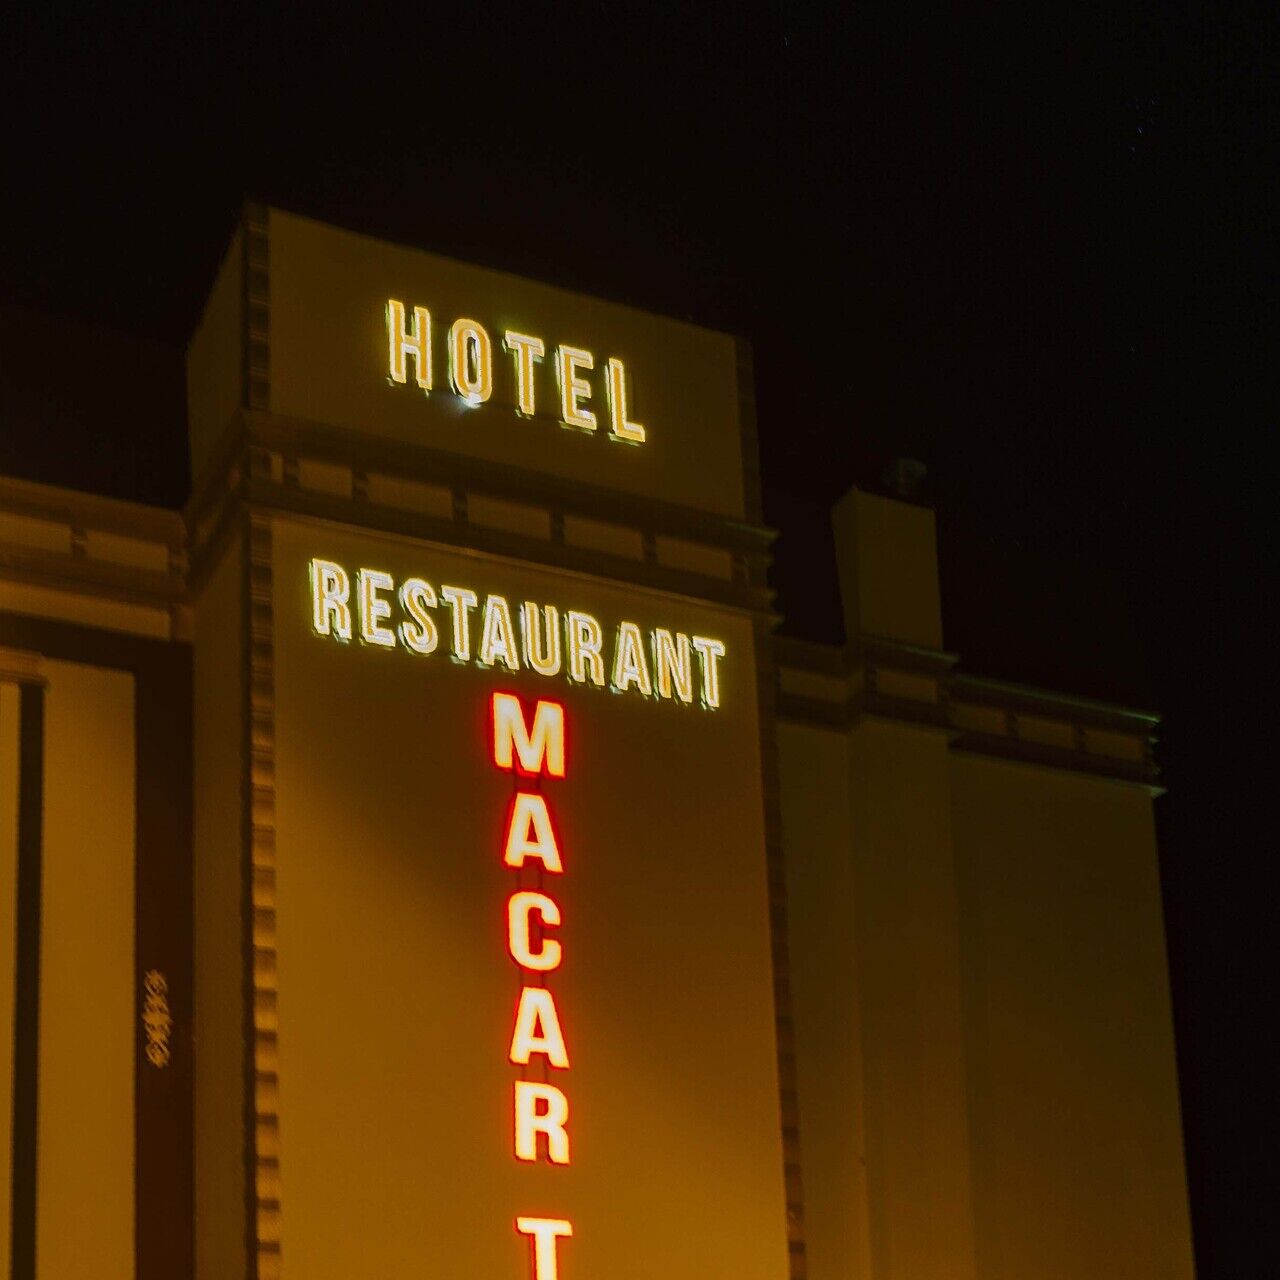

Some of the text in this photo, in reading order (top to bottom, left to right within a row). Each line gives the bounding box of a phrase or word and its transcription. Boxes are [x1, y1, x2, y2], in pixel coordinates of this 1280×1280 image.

[385, 298, 647, 444] HOTEL
[309, 557, 726, 710] RESTAURANT
[491, 691, 571, 1166] MACAR
